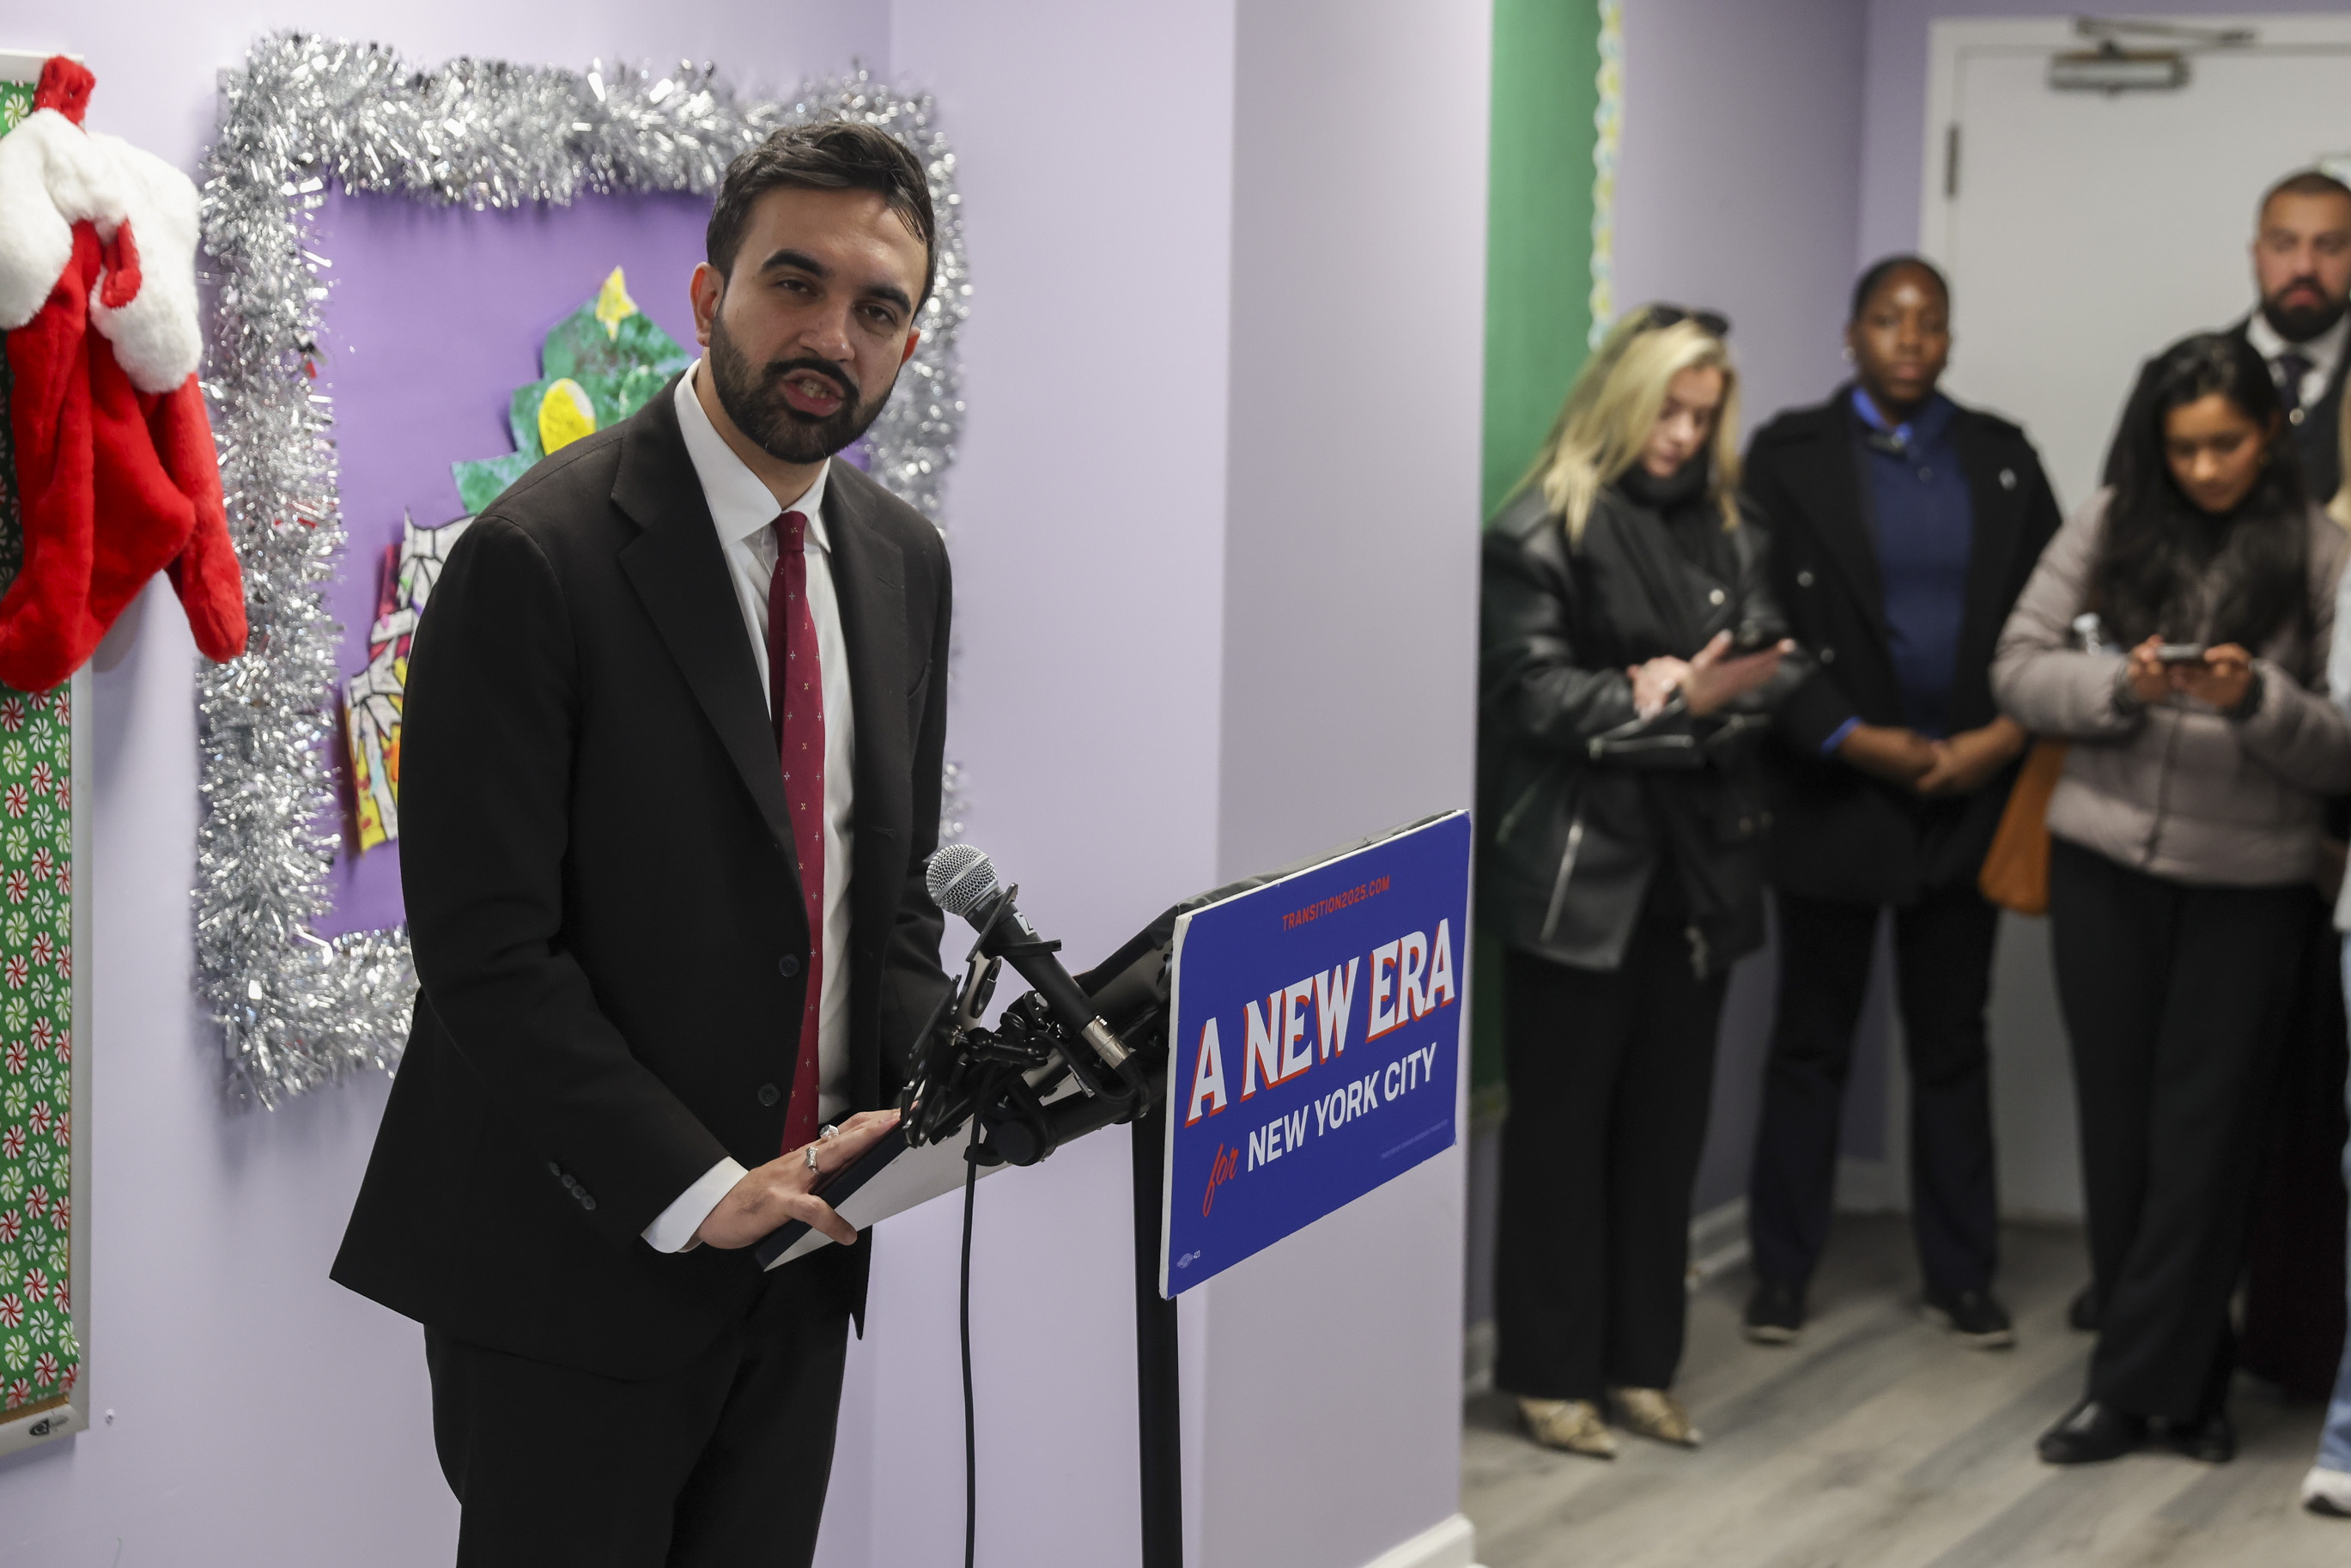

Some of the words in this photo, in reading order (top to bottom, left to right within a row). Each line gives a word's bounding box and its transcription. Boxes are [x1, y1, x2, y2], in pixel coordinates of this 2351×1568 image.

[975, 892, 997, 912] SHURE
[1282, 874, 1390, 932] TRANSITION2025.COM
[1185, 1017, 1228, 1128] A
[1239, 956, 1360, 1103] NEW
[1365, 917, 1455, 1043] ERA
[1202, 1143, 1239, 1218] for
[1248, 1104, 1309, 1173] NEW
[1314, 1069, 1381, 1138] YORK
[1384, 1042, 1437, 1103] CITY
